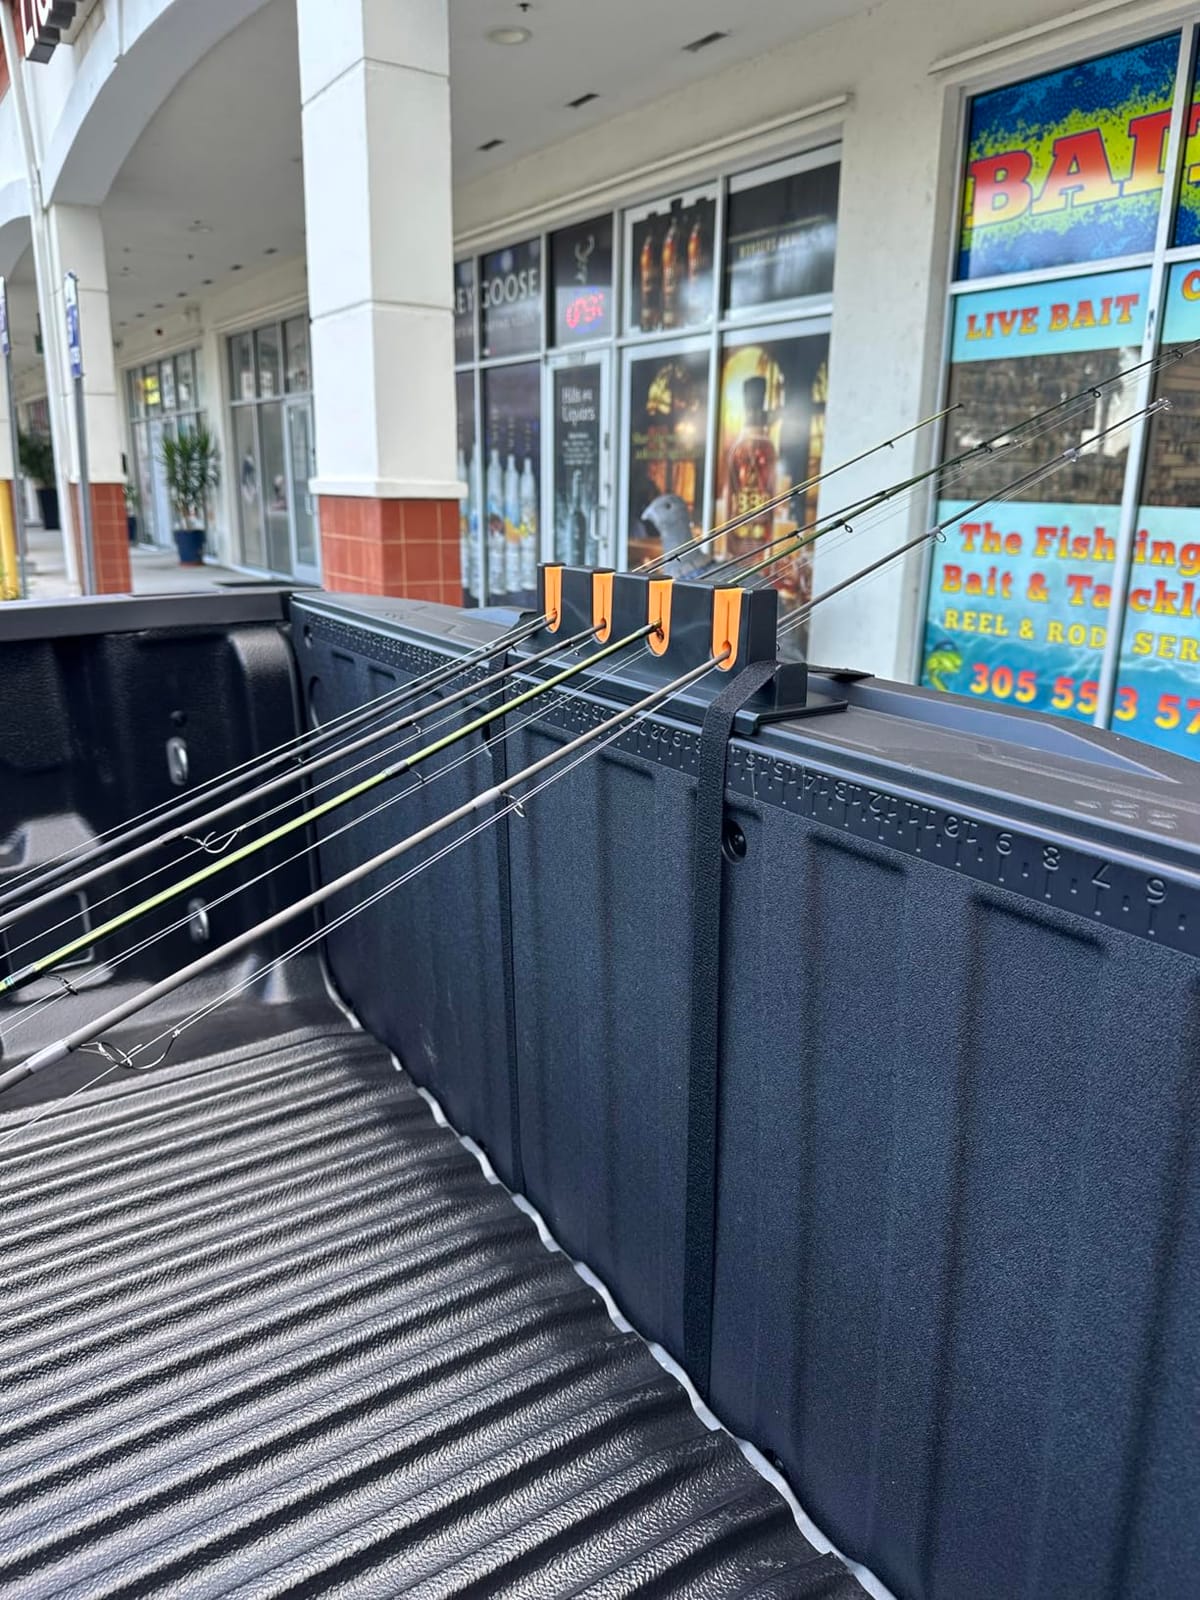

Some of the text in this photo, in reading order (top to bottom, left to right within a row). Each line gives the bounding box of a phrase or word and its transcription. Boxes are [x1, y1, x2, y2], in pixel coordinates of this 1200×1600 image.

[966, 293, 1140, 341] LIVE BAIT
[959, 522, 1022, 555] The
[942, 564, 1200, 618] Bait & Tackl
[944, 608, 1009, 637] REEL
[1018, 617, 1035, 641] &
[1047, 620, 1108, 649] ROD
[970, 662, 1037, 703] 305
[1042, 846, 1061, 871] 8
